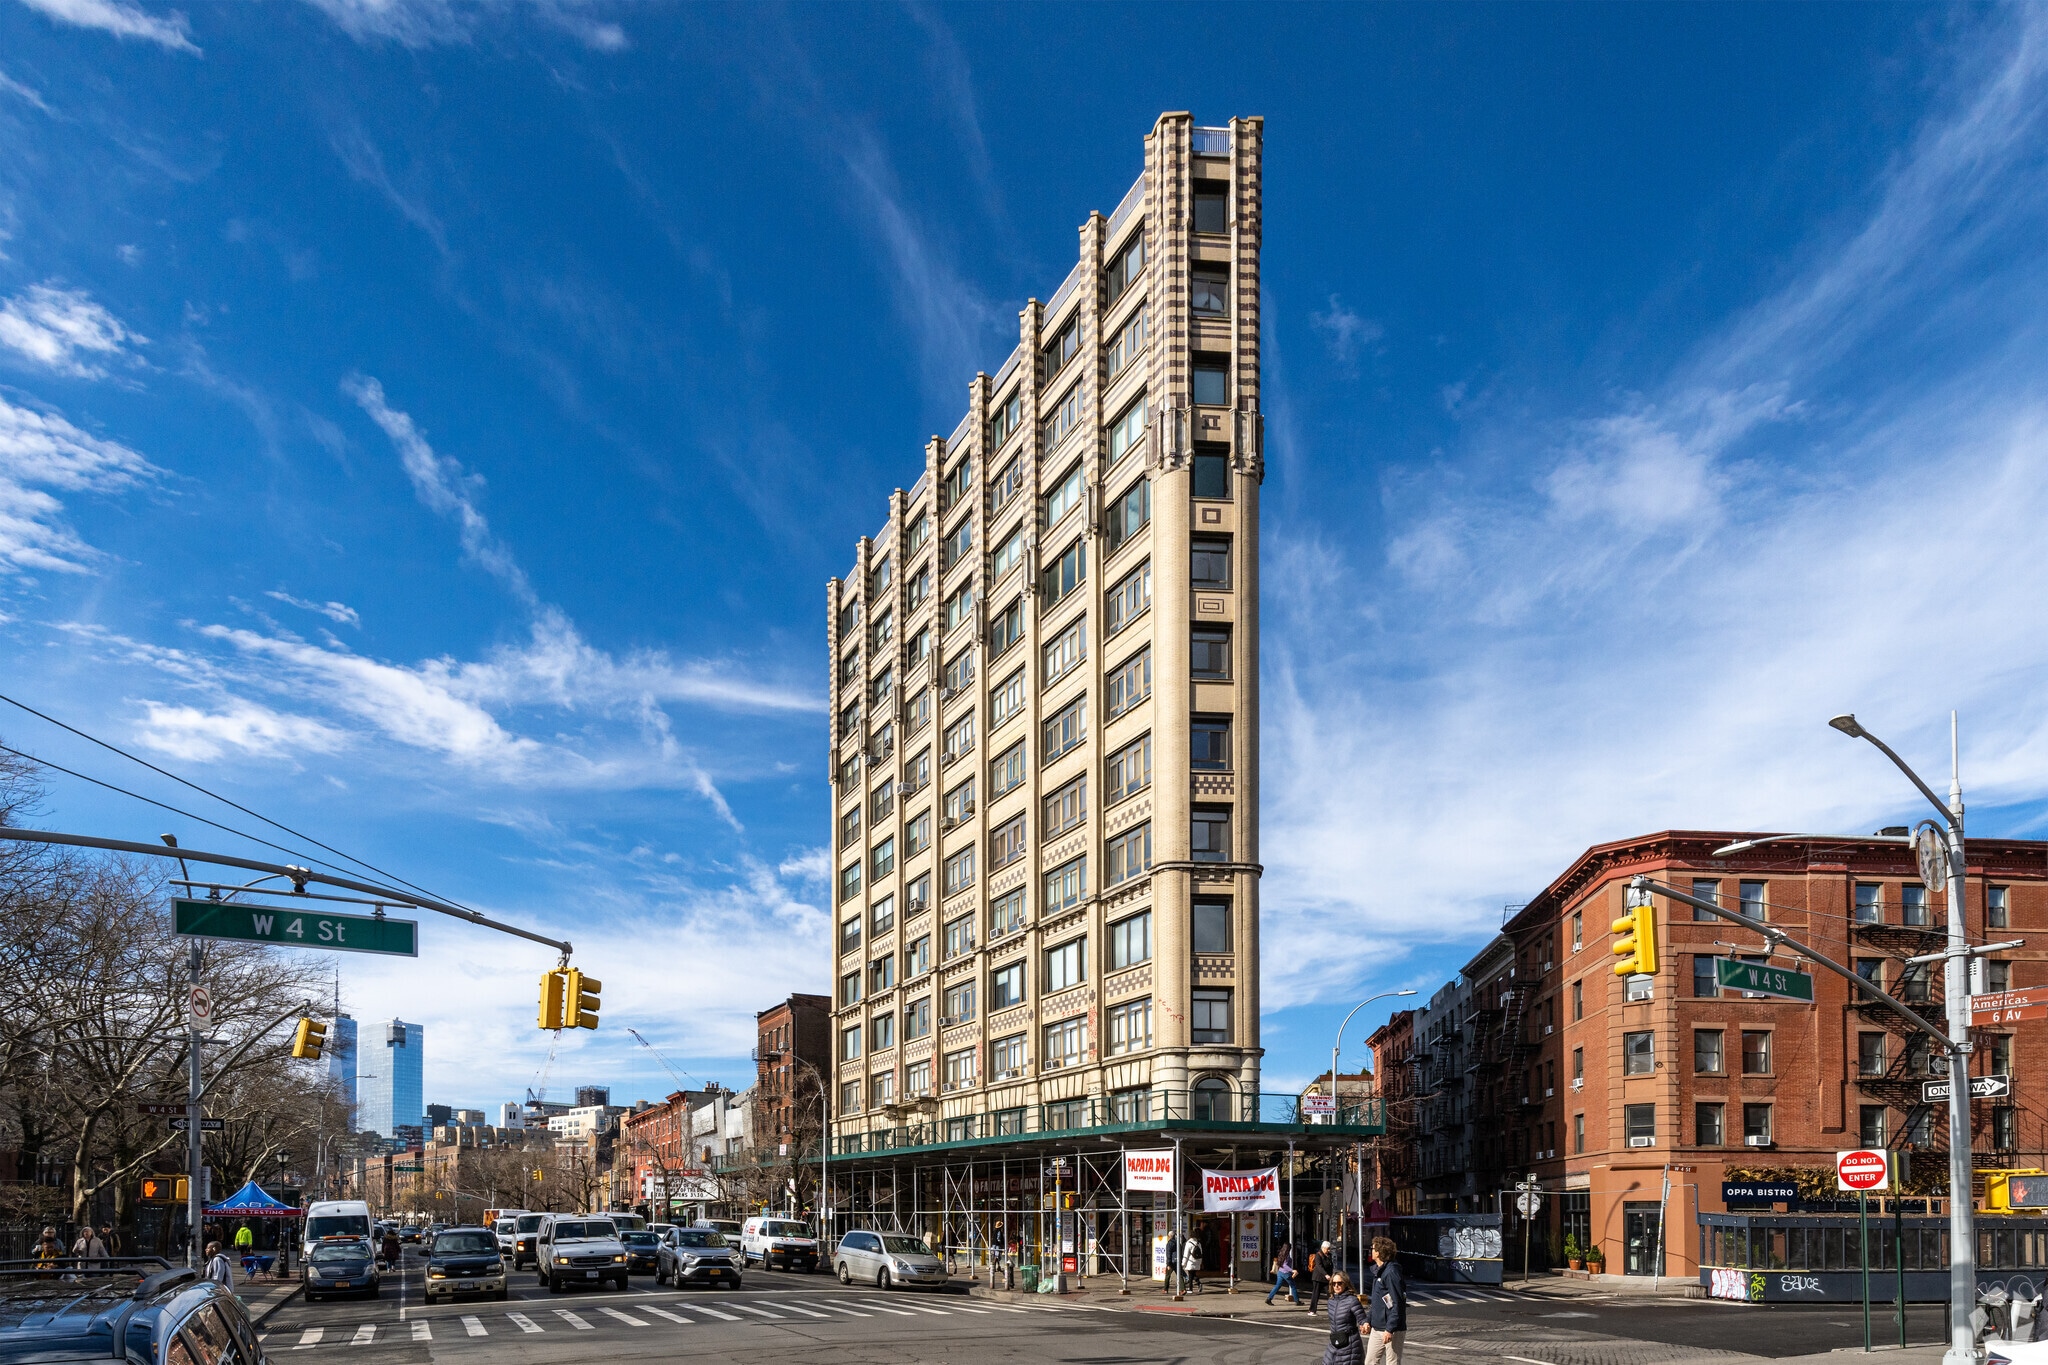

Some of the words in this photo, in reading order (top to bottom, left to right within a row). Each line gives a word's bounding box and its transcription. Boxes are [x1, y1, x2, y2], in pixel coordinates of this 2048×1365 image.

[252, 913, 274, 936] W
[286, 918, 304, 939] 4
[317, 920, 346, 943] St
[1748, 968, 1758, 987] W
[1762, 971, 1771, 989] 4
[1775, 973, 1787, 992] St
[1972, 996, 2028, 1010] Americas
[1992, 1011, 2000, 1022] 6
[2006, 1009, 2022, 1021] Av
[1969, 1082, 1996, 1092] WAY
[169, 1106, 177, 1114] St
[1127, 1157, 1154, 1173] PAPAYA
[1155, 1157, 1170, 1173] DOG
[1206, 1176, 1251, 1193] PAPAYA
[1252, 1174, 1275, 1192] DOG
[1848, 1173, 1876, 1182] ENTER
[1727, 1188, 1754, 1197] OPPA
[1757, 1188, 1794, 1197] BISTRO
[1241, 1250, 1259, 1259] $1.49
